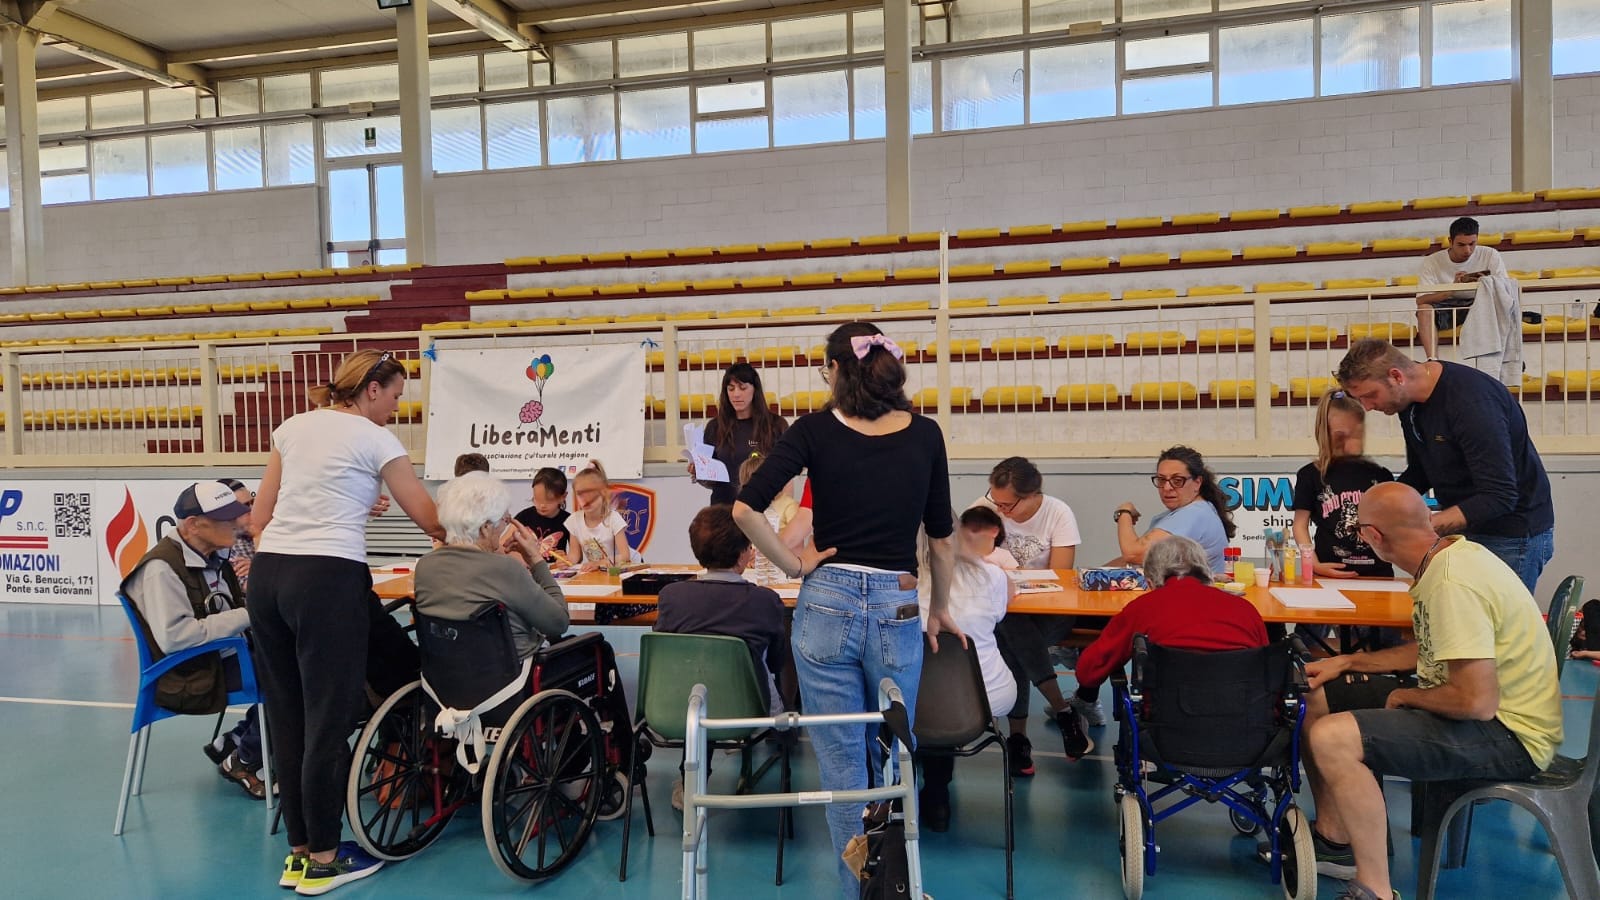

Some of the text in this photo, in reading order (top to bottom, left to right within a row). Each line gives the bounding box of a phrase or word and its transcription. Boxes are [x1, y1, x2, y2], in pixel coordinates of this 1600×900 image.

[470, 422, 600, 449] LiberaMenti
[1218, 477, 1296, 511] SIM
[16, 521, 48, 531] s.n.c.
[1263, 515, 1294, 529] ship
[0, 553, 60, 571] MAZIONI
[6, 574, 94, 586] Via G. Benucci, 171
[6, 584, 93, 595] Ponte san Giovanni
